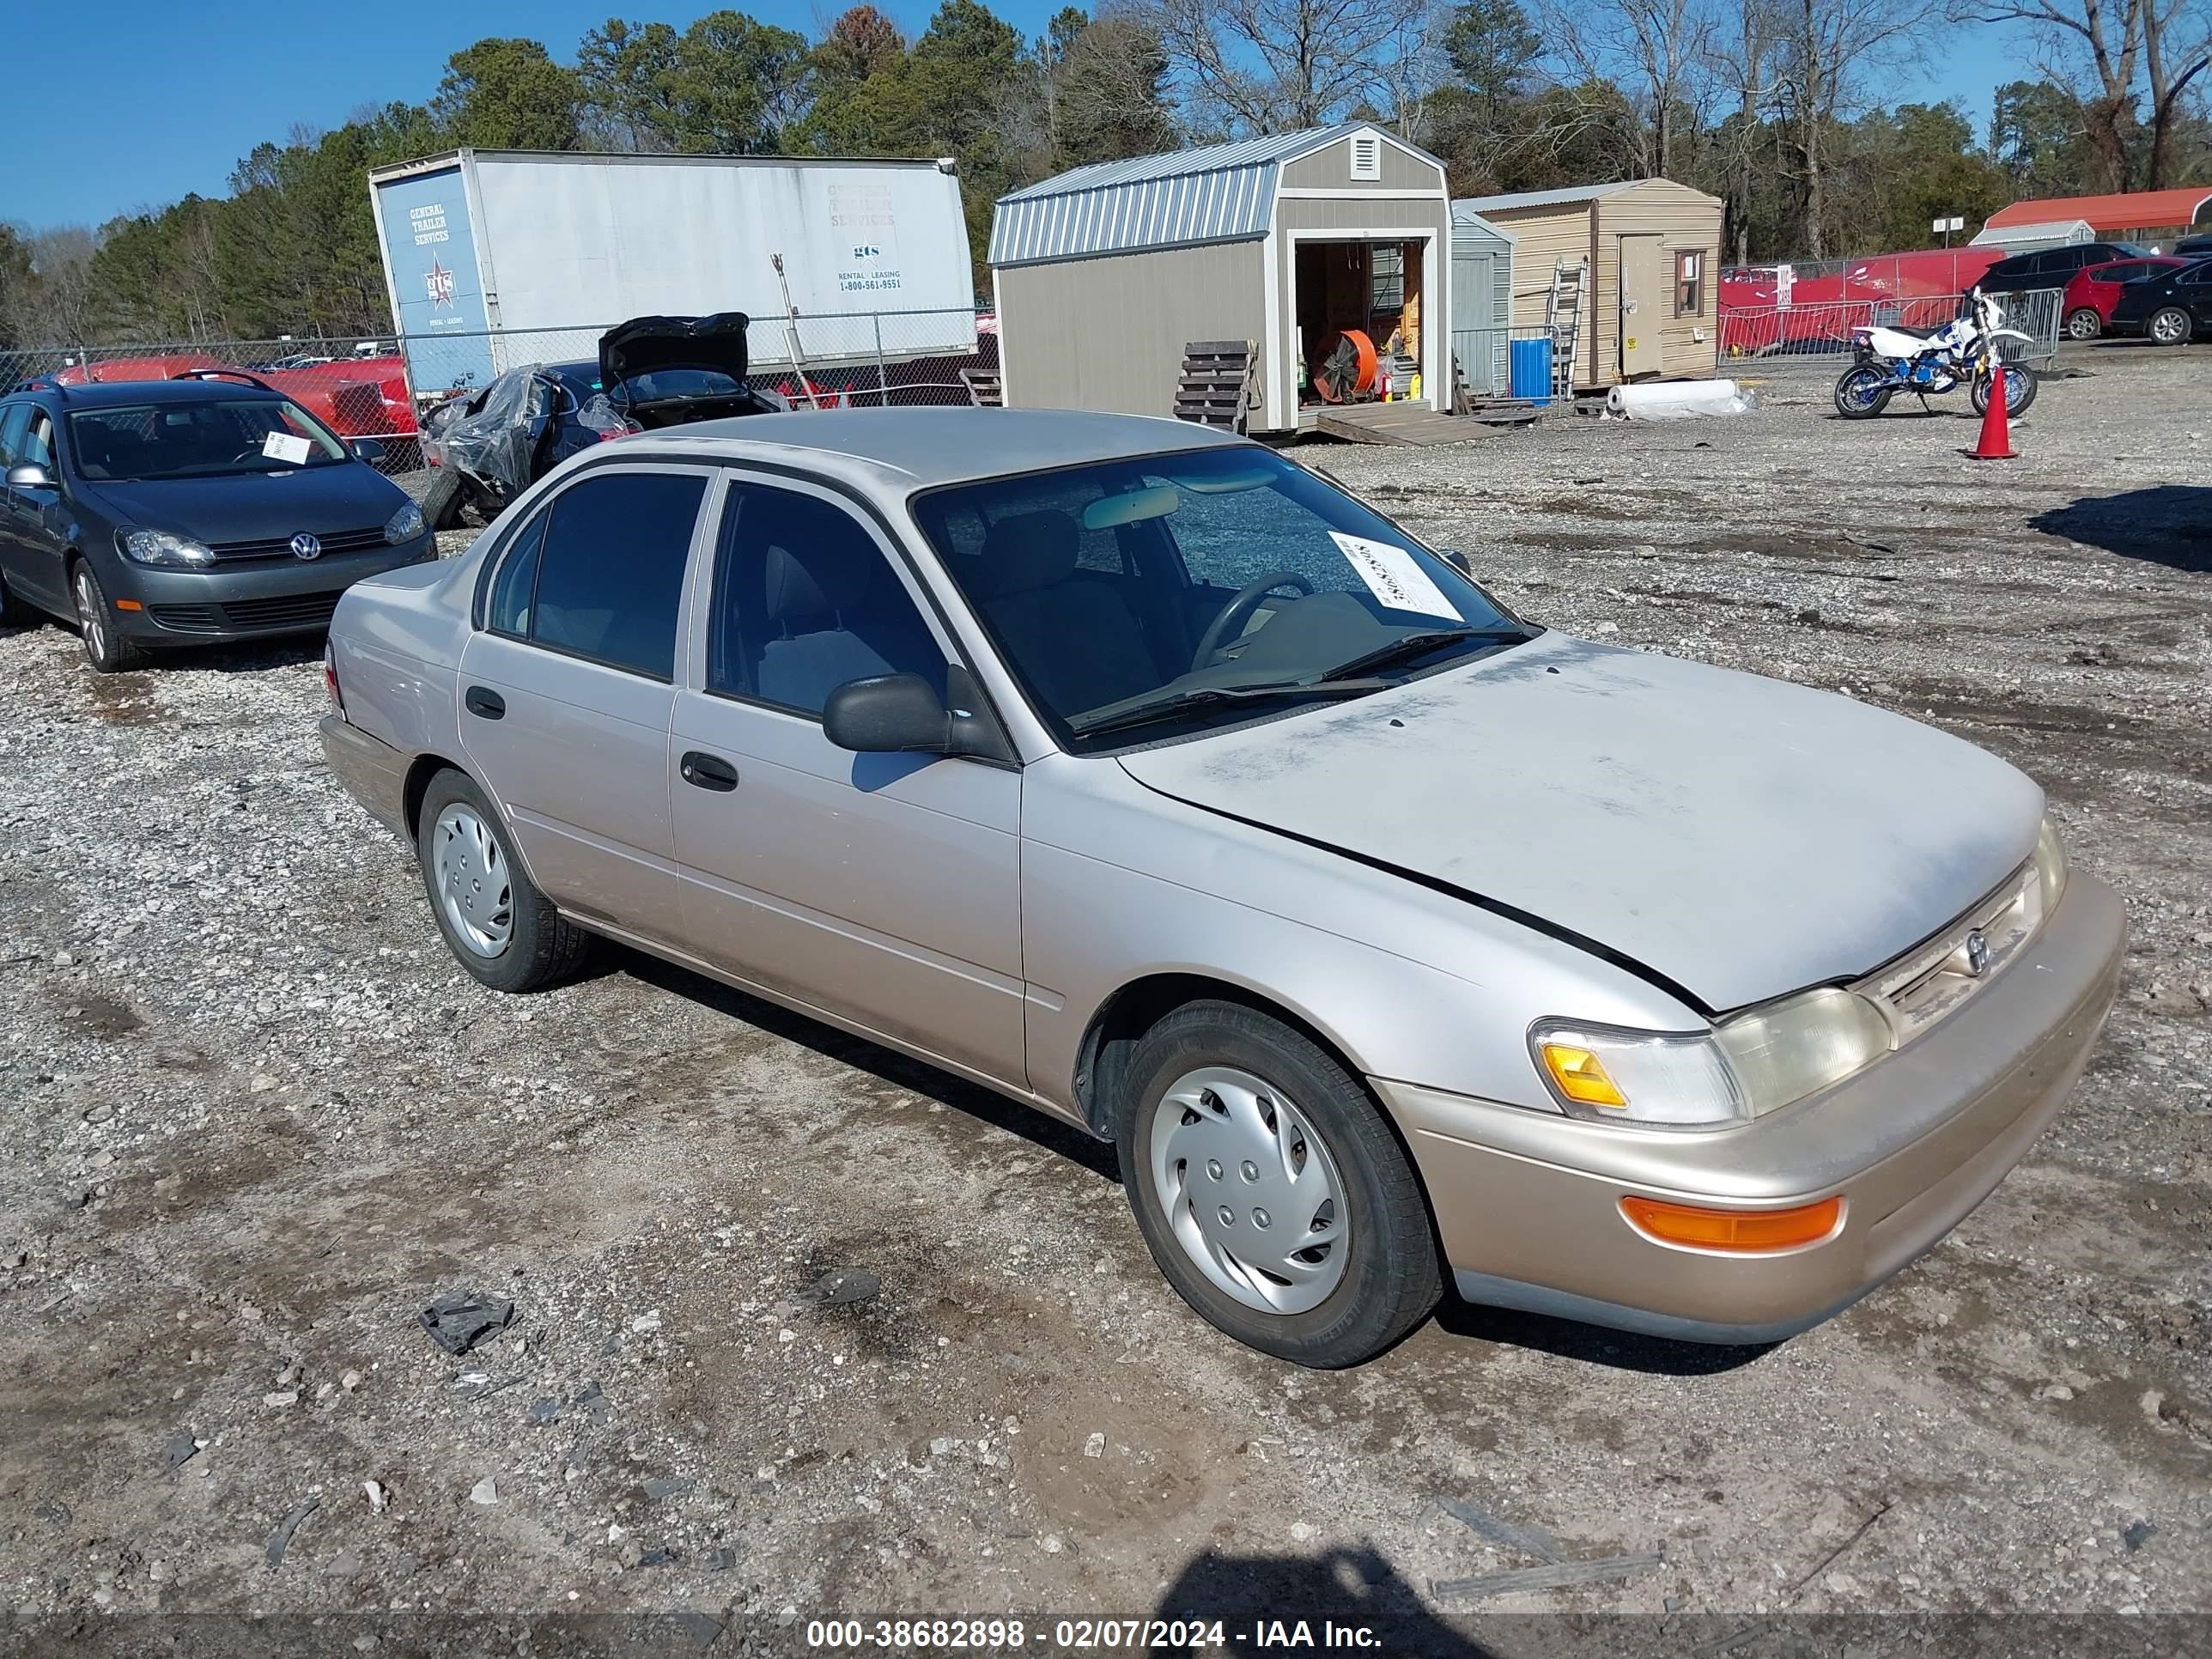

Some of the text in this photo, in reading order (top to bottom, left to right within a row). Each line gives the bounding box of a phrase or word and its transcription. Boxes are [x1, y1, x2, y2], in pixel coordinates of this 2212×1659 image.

[410, 204, 445, 219] GENERAL
[411, 216, 447, 232] TRAILER
[1952, 220, 1961, 228] A
[415, 230, 449, 246] SERVICES
[854, 246, 879, 259] gts
[871, 270, 901, 279] LEASING
[1778, 289, 1790, 304] CARS
[1354, 544, 1411, 605] 38682898
